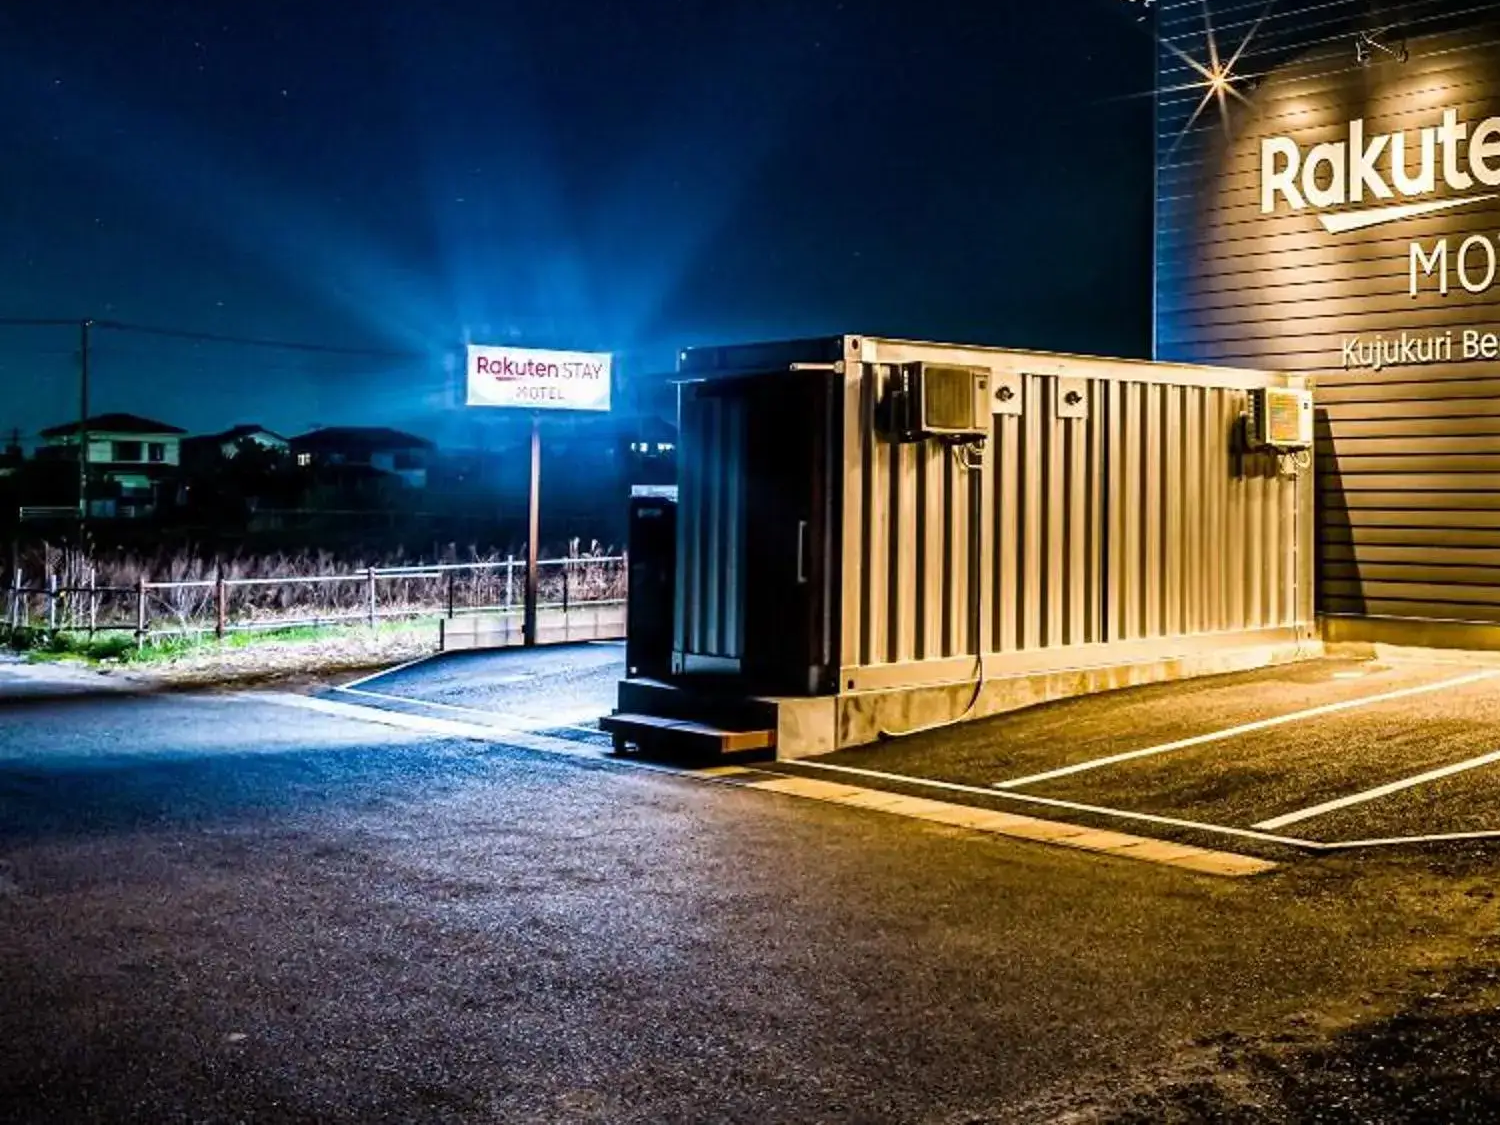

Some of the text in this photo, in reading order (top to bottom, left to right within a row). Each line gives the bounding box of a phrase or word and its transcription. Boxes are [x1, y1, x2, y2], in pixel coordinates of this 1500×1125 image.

[1341, 330, 1452, 370] Kujukuri
[476, 356, 603, 380] Rakuten STAY
[515, 386, 565, 400] MOTEL
